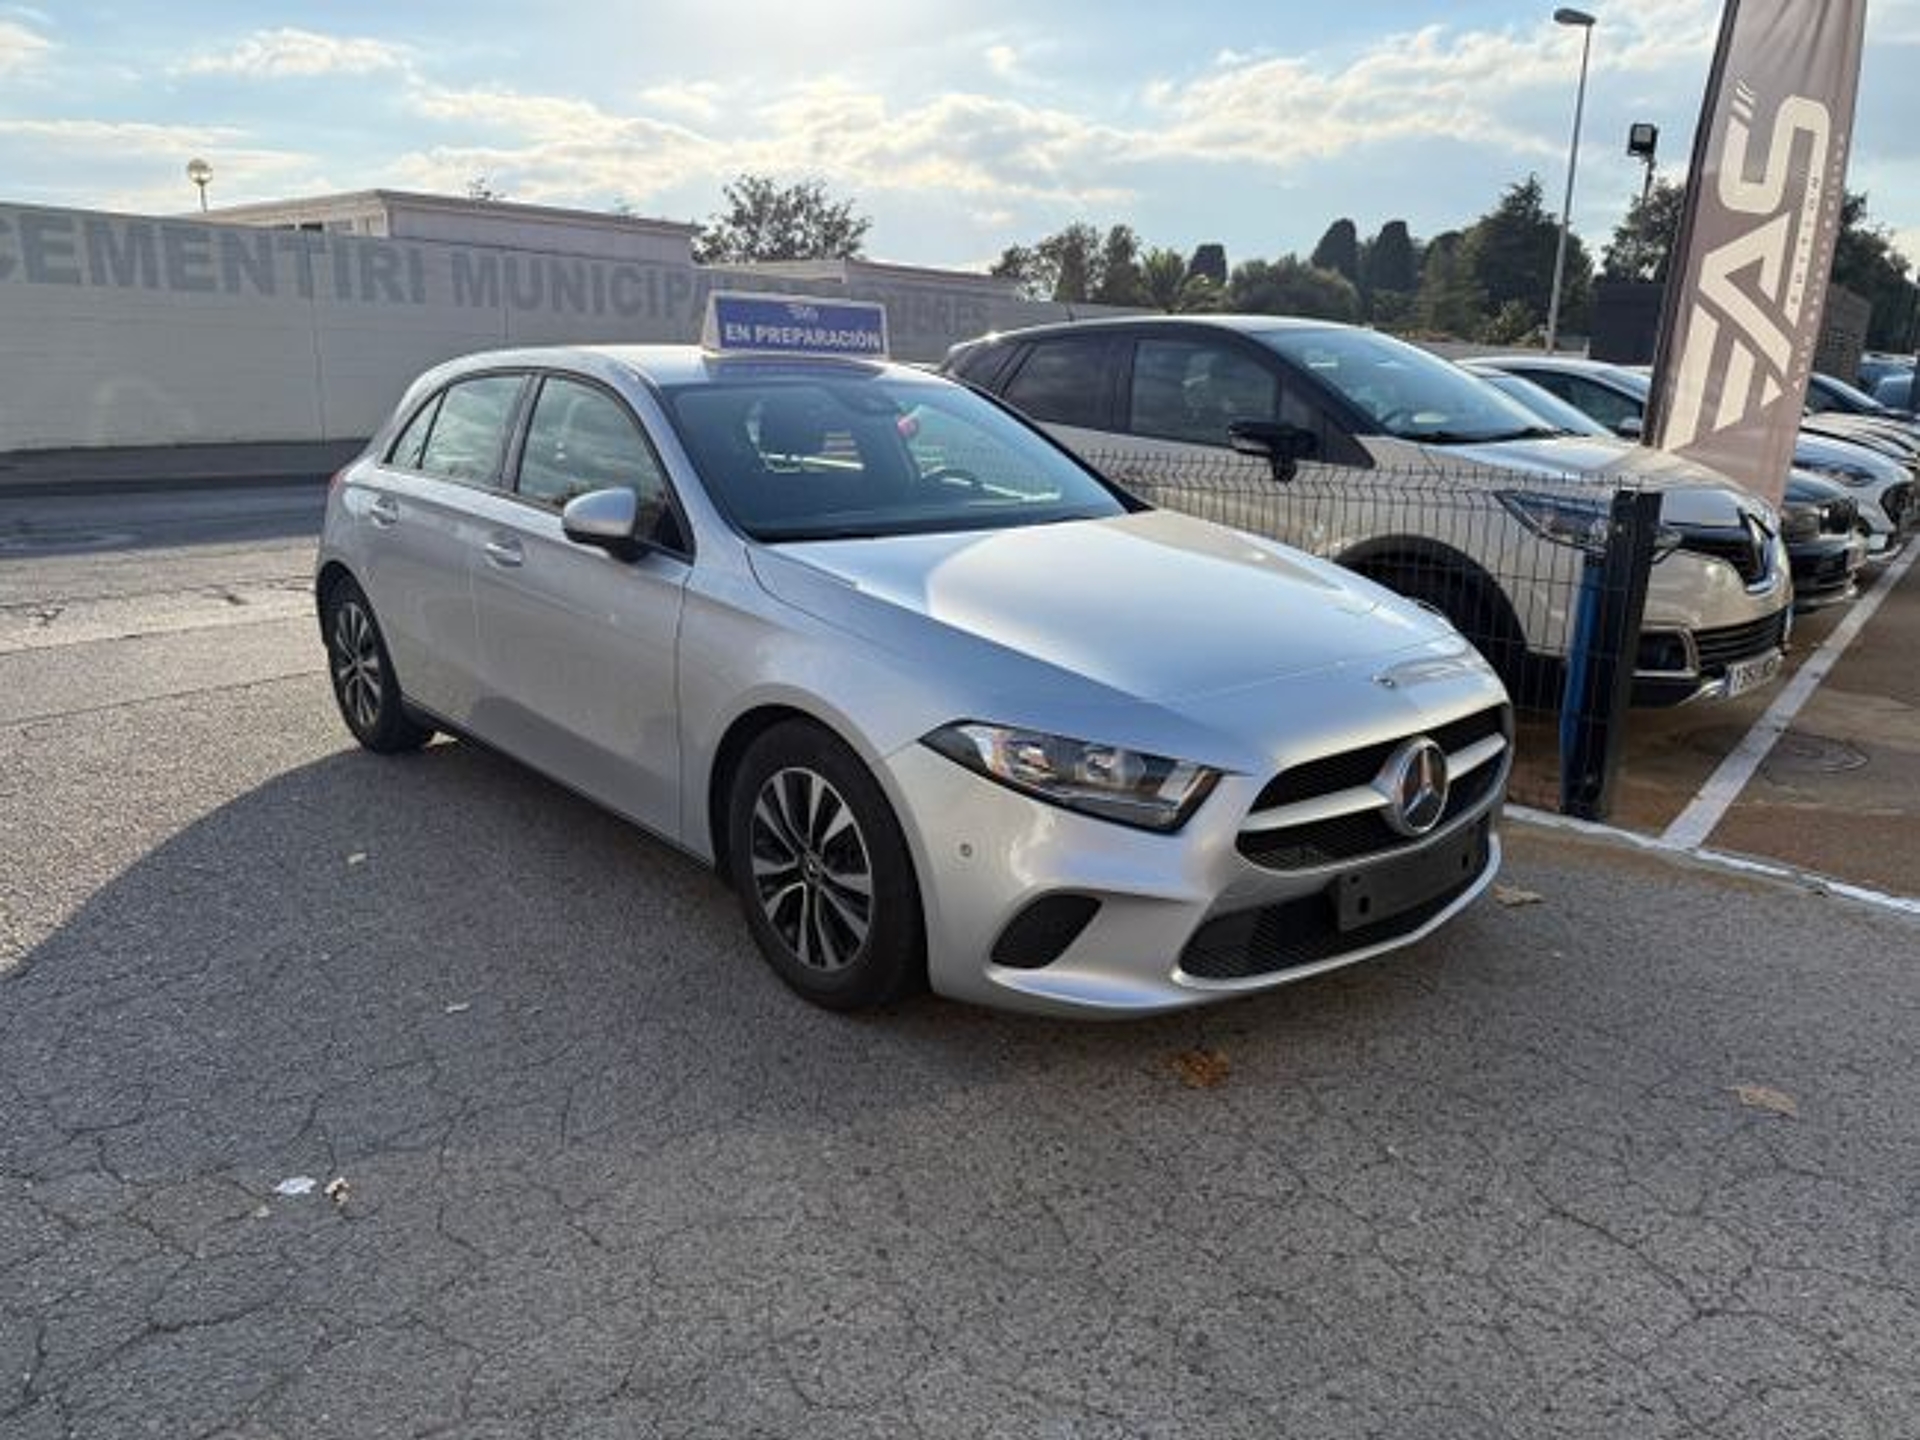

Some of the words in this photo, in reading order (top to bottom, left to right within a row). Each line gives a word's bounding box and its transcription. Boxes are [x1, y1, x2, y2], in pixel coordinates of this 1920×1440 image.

[450, 249, 735, 326] MUNICIPA
[725, 324, 751, 342] EN
[755, 325, 881, 349] PREPARACIÓN
